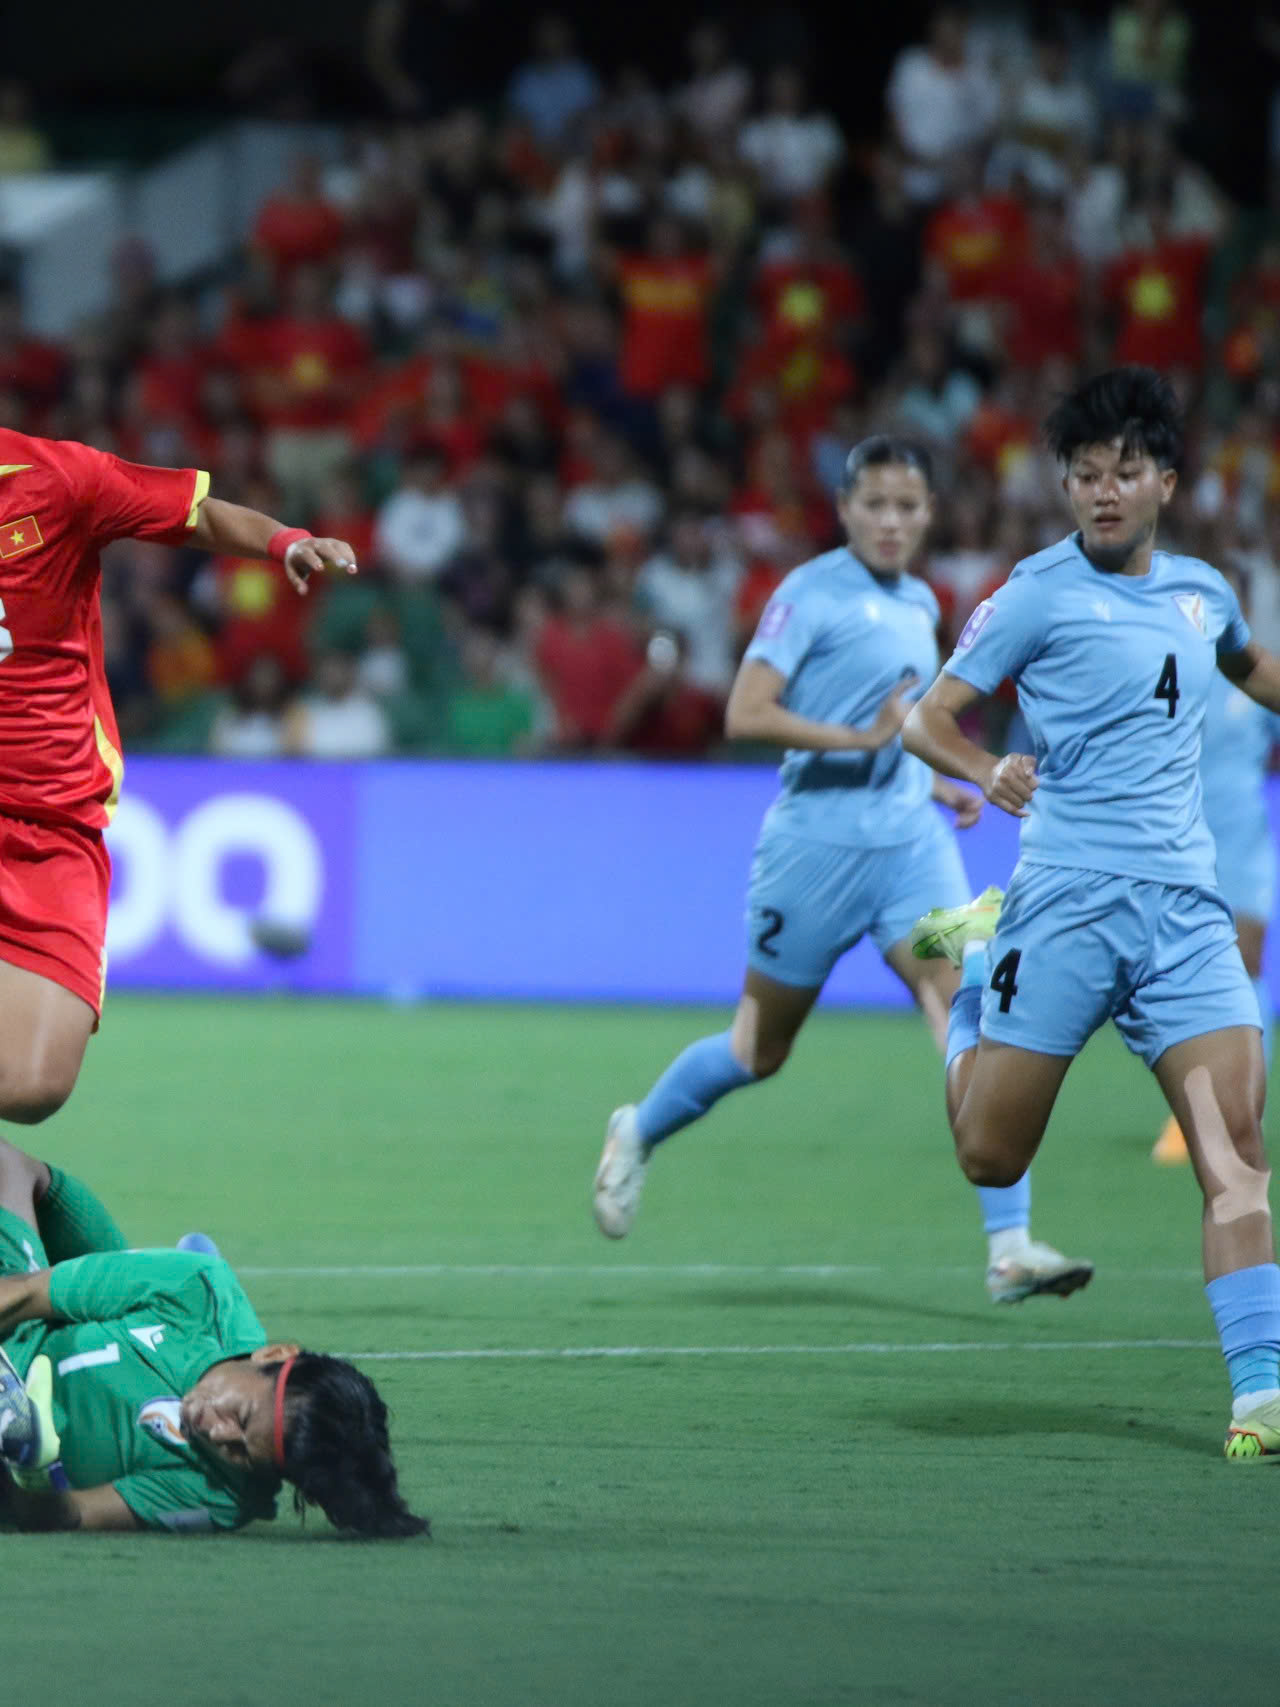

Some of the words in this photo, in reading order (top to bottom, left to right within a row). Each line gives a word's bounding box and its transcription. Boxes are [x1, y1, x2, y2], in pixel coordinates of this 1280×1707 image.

[1153, 652, 1180, 719] 4
[756, 906, 785, 960] 2
[990, 947, 1022, 1014] 4
[57, 1341, 120, 1376] 1
